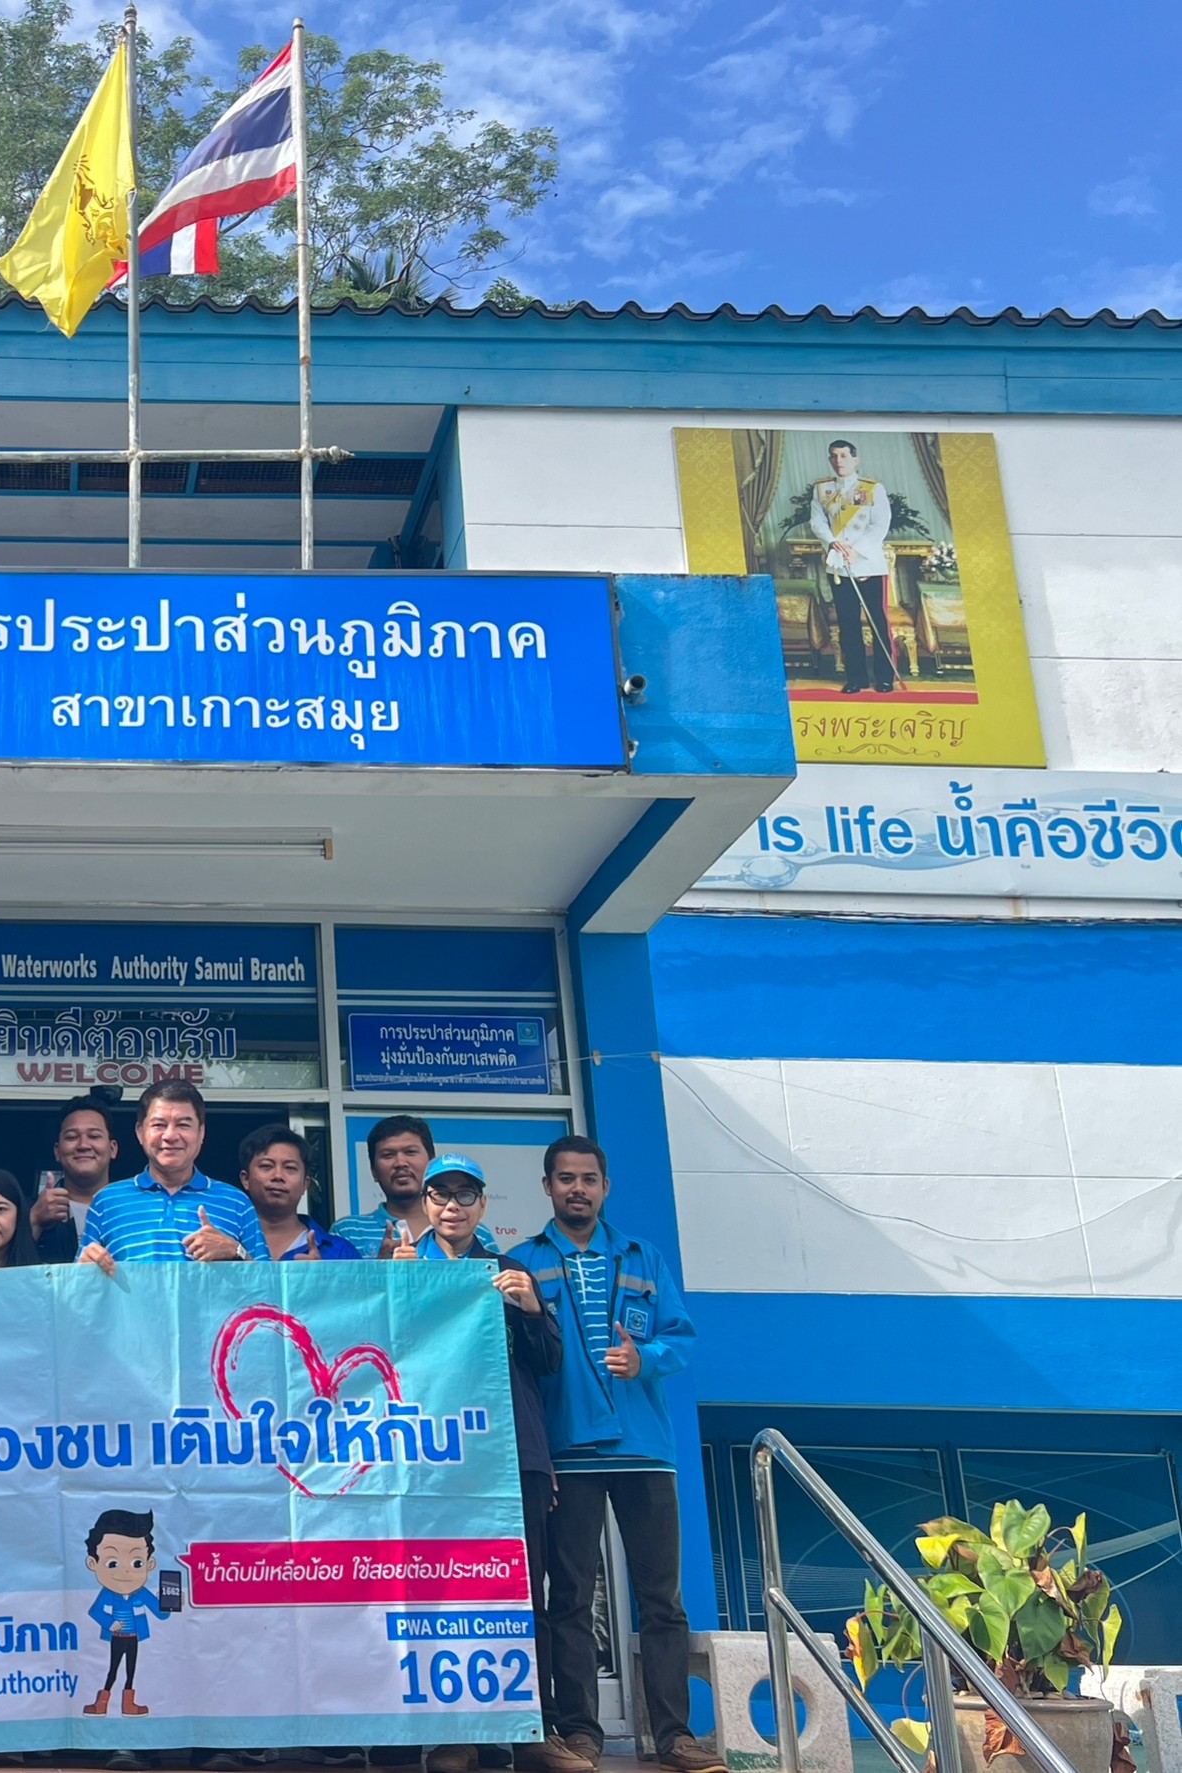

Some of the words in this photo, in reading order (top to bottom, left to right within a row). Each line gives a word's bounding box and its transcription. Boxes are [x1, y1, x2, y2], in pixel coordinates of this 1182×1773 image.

[50, 693, 400, 751] สาขาเกาะสมุย
[796, 710, 970, 747] รงพระเจริญ
[825, 804, 913, 855] life
[2, 954, 97, 979] Waterworks
[111, 954, 188, 986] Authority
[195, 956, 244, 981] Samui
[251, 957, 305, 982] Branch
[379, 1022, 515, 1048] การประปาส่วนภูมิภาค
[380, 1041, 517, 1070] มุ่งมั่นป้องกันยาเสพติด
[17, 1062, 205, 1084] WELCOME
[495, 1226, 518, 1235] true
[152, 1401, 488, 1465] เติมใจให้กัน"
[197, 1552, 344, 1582] "น้ำดิบมีเหลือน้อย
[352, 1555, 520, 1581] ใช้สอยต้องประหยัด"
[161, 1587, 180, 1596] 1662
[396, 1618, 432, 1636] PWA
[436, 1617, 469, 1635] Call
[473, 1617, 529, 1635] Center
[399, 1648, 533, 1705] 1662
